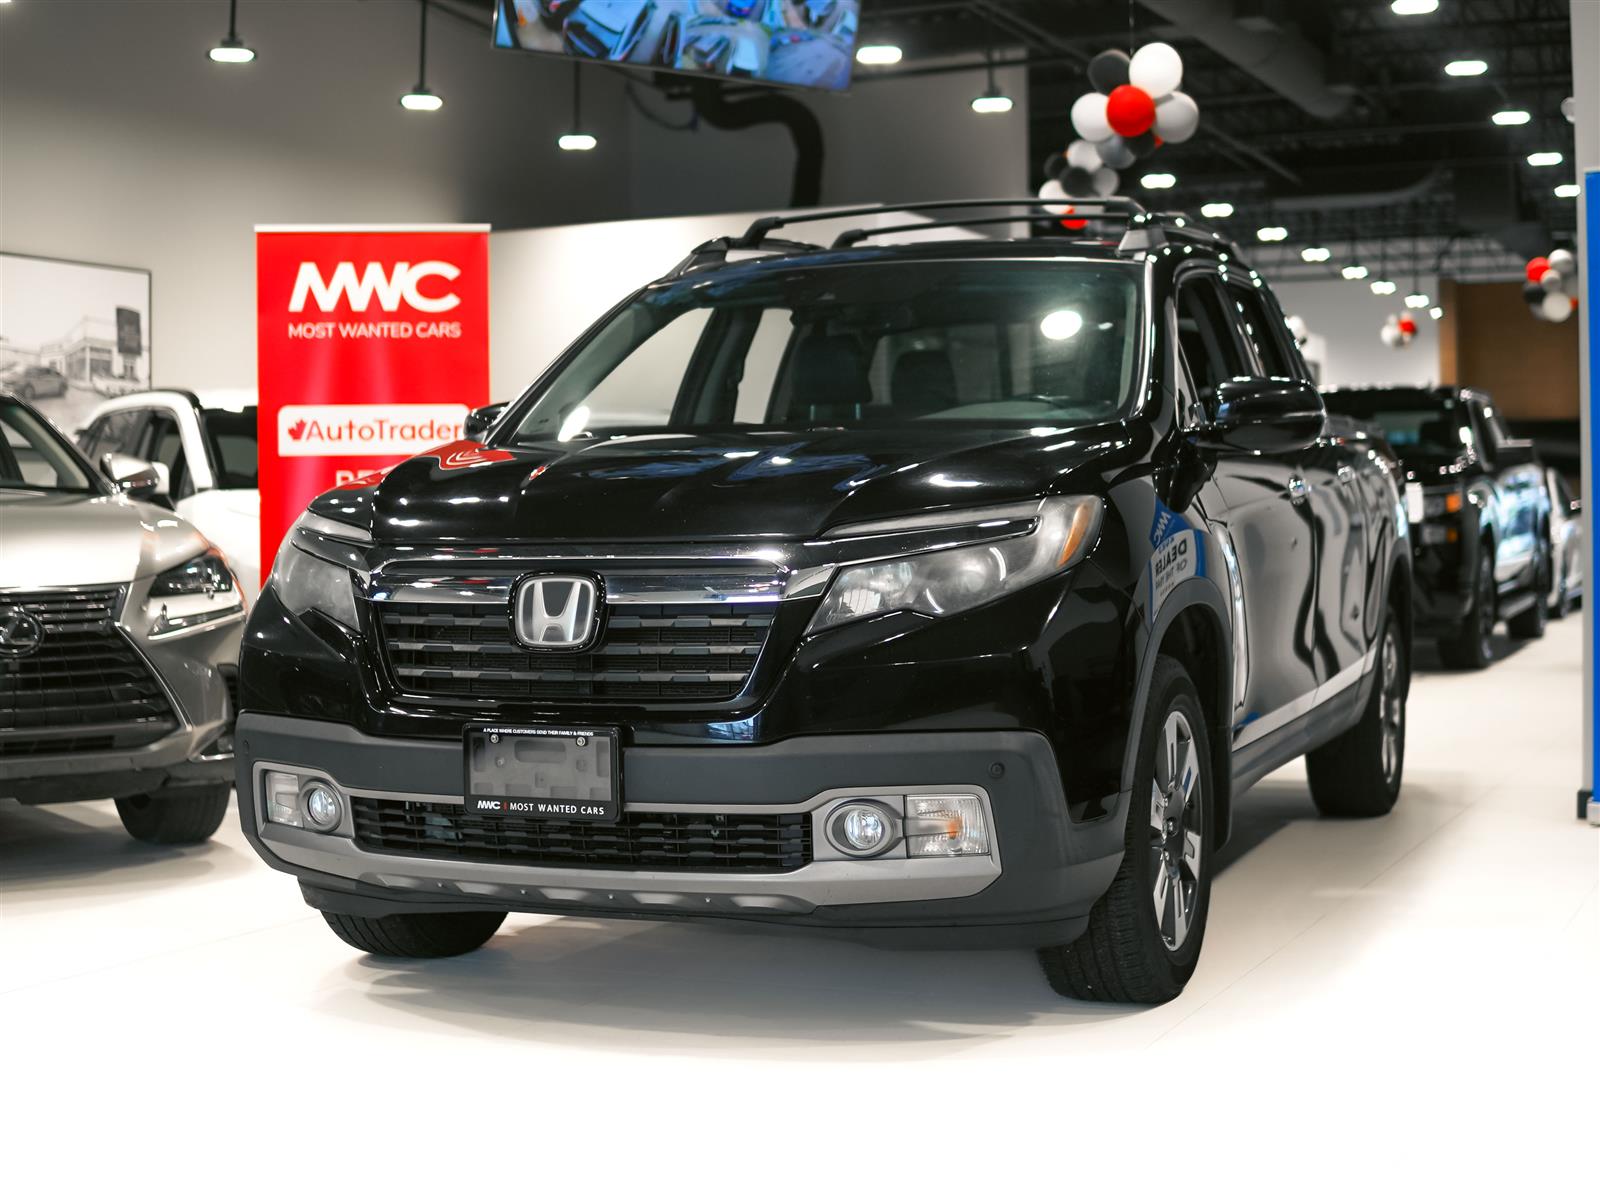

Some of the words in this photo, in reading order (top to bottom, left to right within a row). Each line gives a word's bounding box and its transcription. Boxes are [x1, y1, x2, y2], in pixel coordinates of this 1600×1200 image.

[288, 261, 461, 312] MWC
[288, 322, 335, 339] MOST
[338, 322, 413, 339] WANTED
[415, 321, 462, 338] CARS
[305, 419, 462, 441] AutoTrader
[477, 800, 501, 811] MWC
[509, 802, 534, 812] MOST
[538, 804, 577, 814] WANTED
[580, 806, 605, 815] CARS
